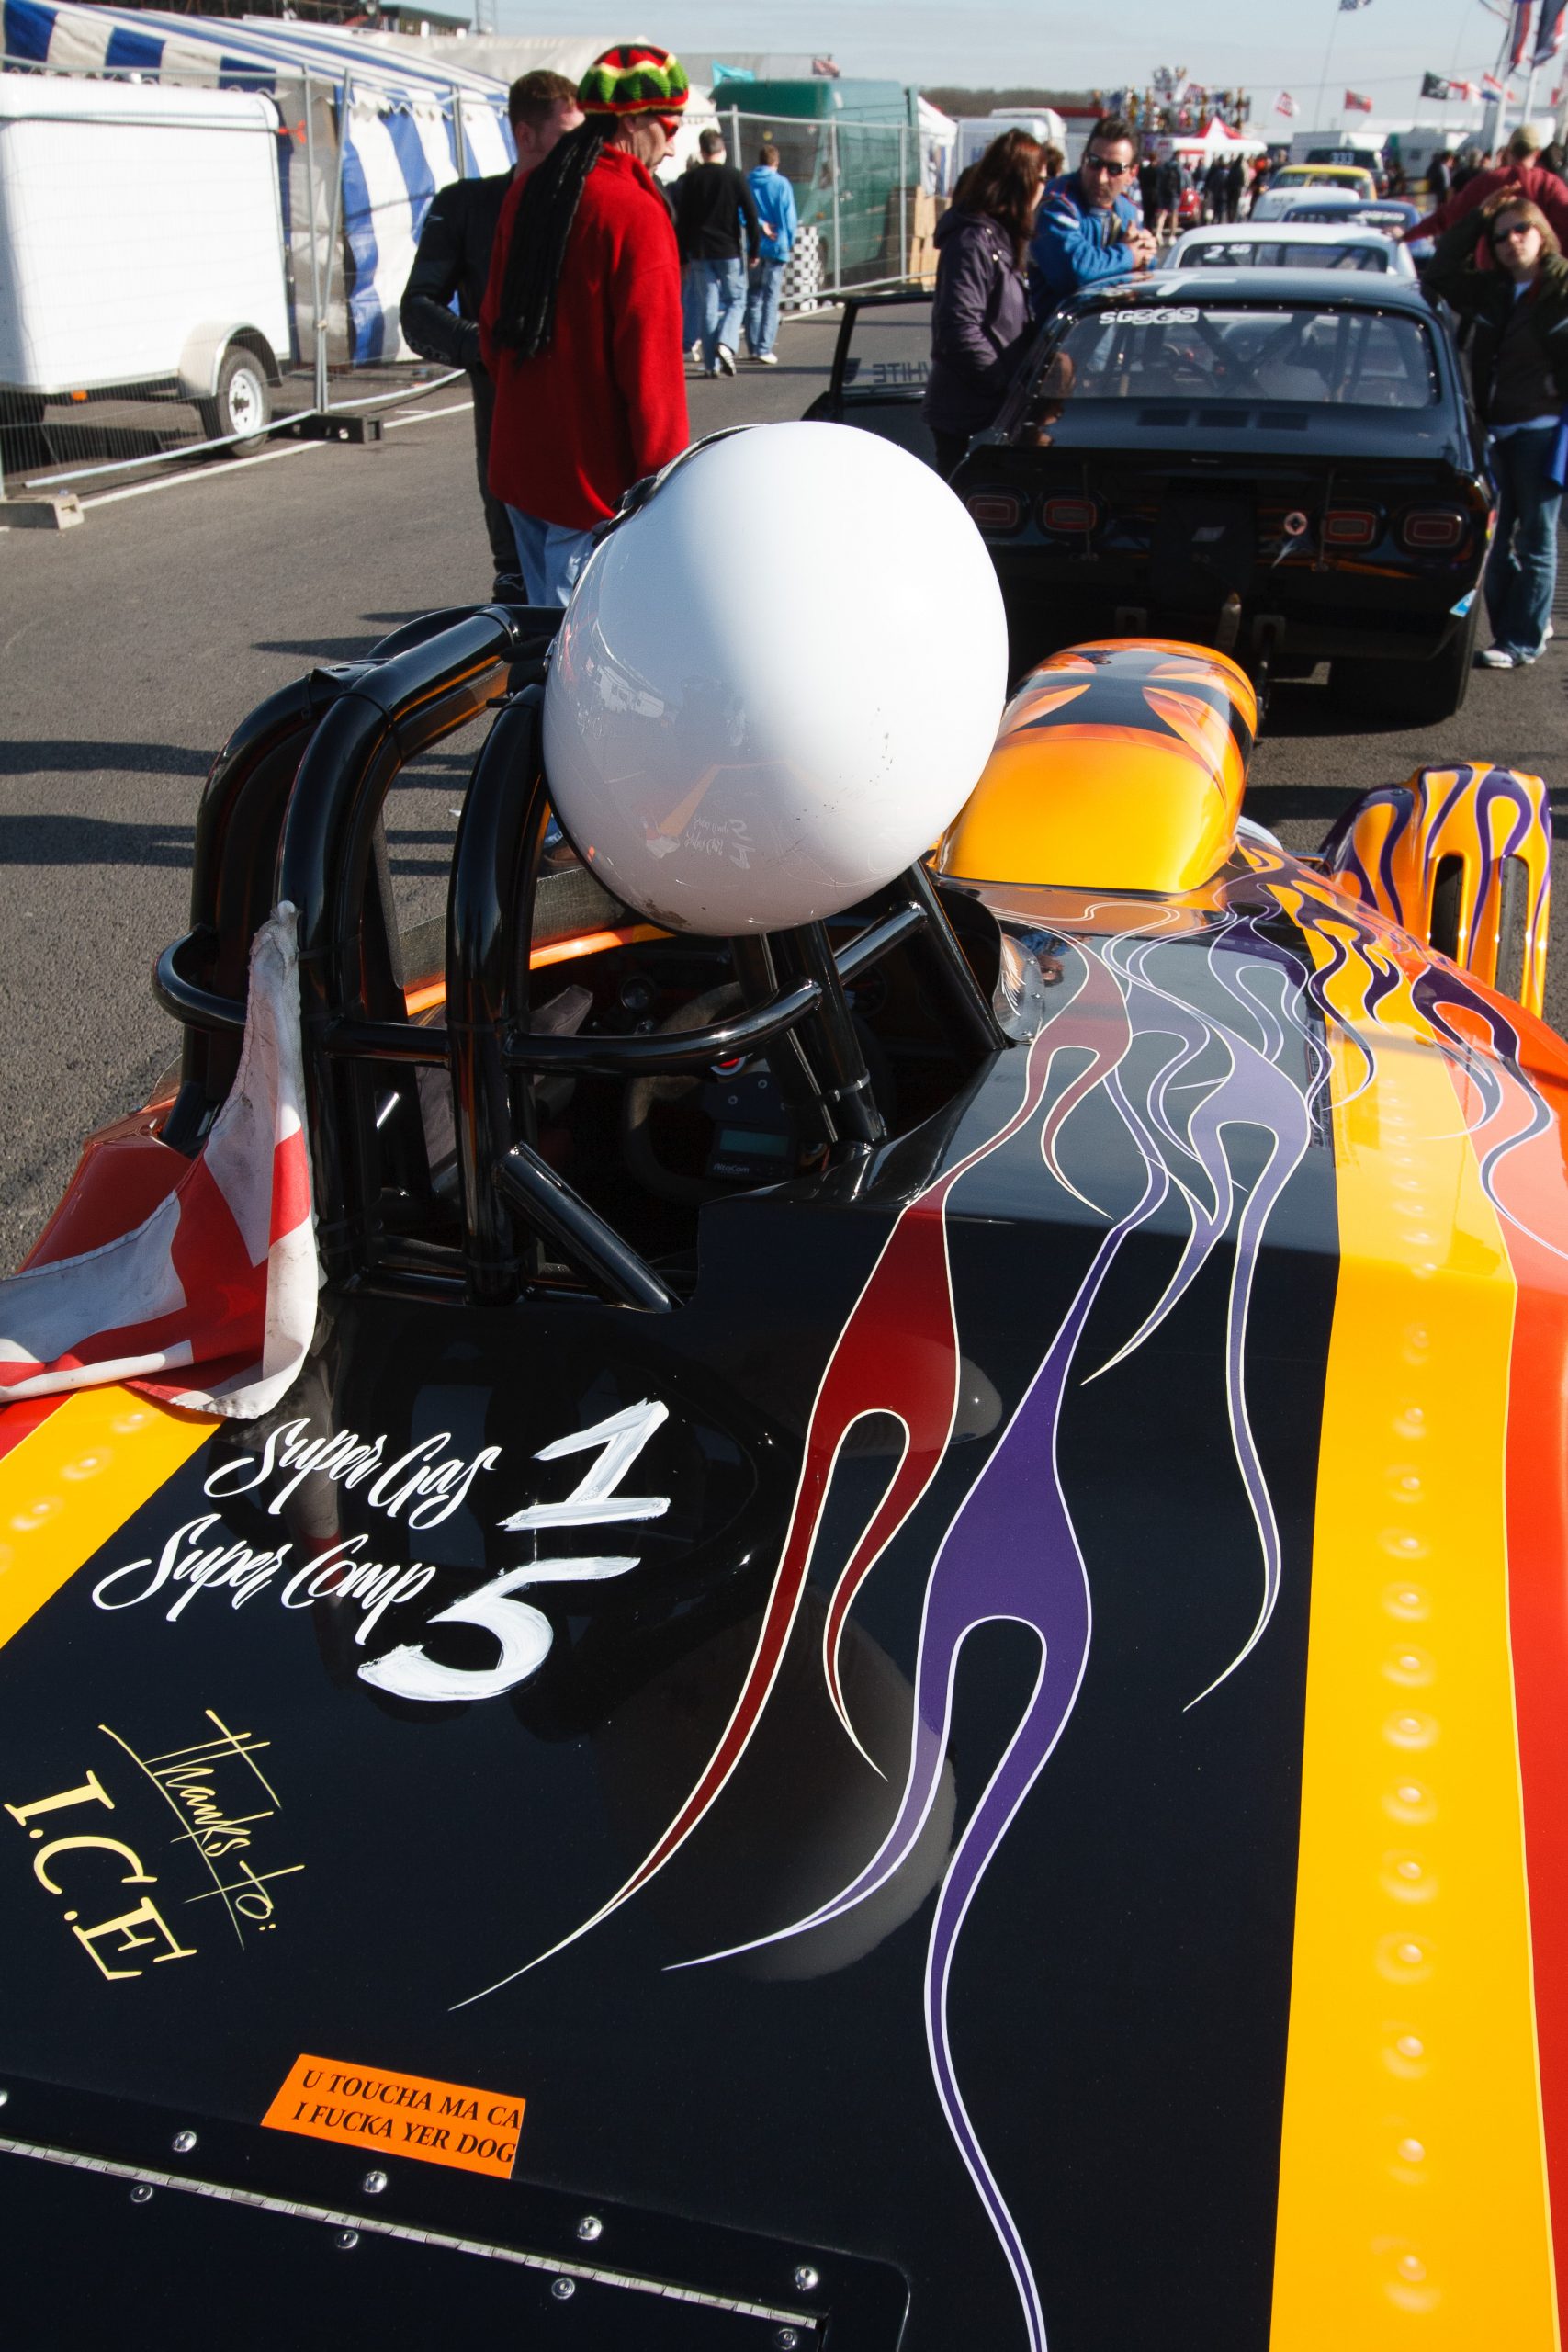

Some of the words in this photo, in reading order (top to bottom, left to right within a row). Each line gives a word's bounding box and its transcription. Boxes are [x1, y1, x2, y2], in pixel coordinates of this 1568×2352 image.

[204, 1418, 387, 1514] Super
[368, 1433, 502, 1529] Gas
[93, 1514, 292, 1622] Super
[281, 1534, 436, 1645] Comp
[291, 2101, 308, 2121] I
[308, 2104, 393, 2139] FUCKA
[401, 2122, 451, 2150] YER
[456, 2133, 517, 2164] DOG
[302, 2069, 324, 2089] U
[327, 2074, 432, 2111] TOUCHA
[437, 2096, 479, 2122] MA
